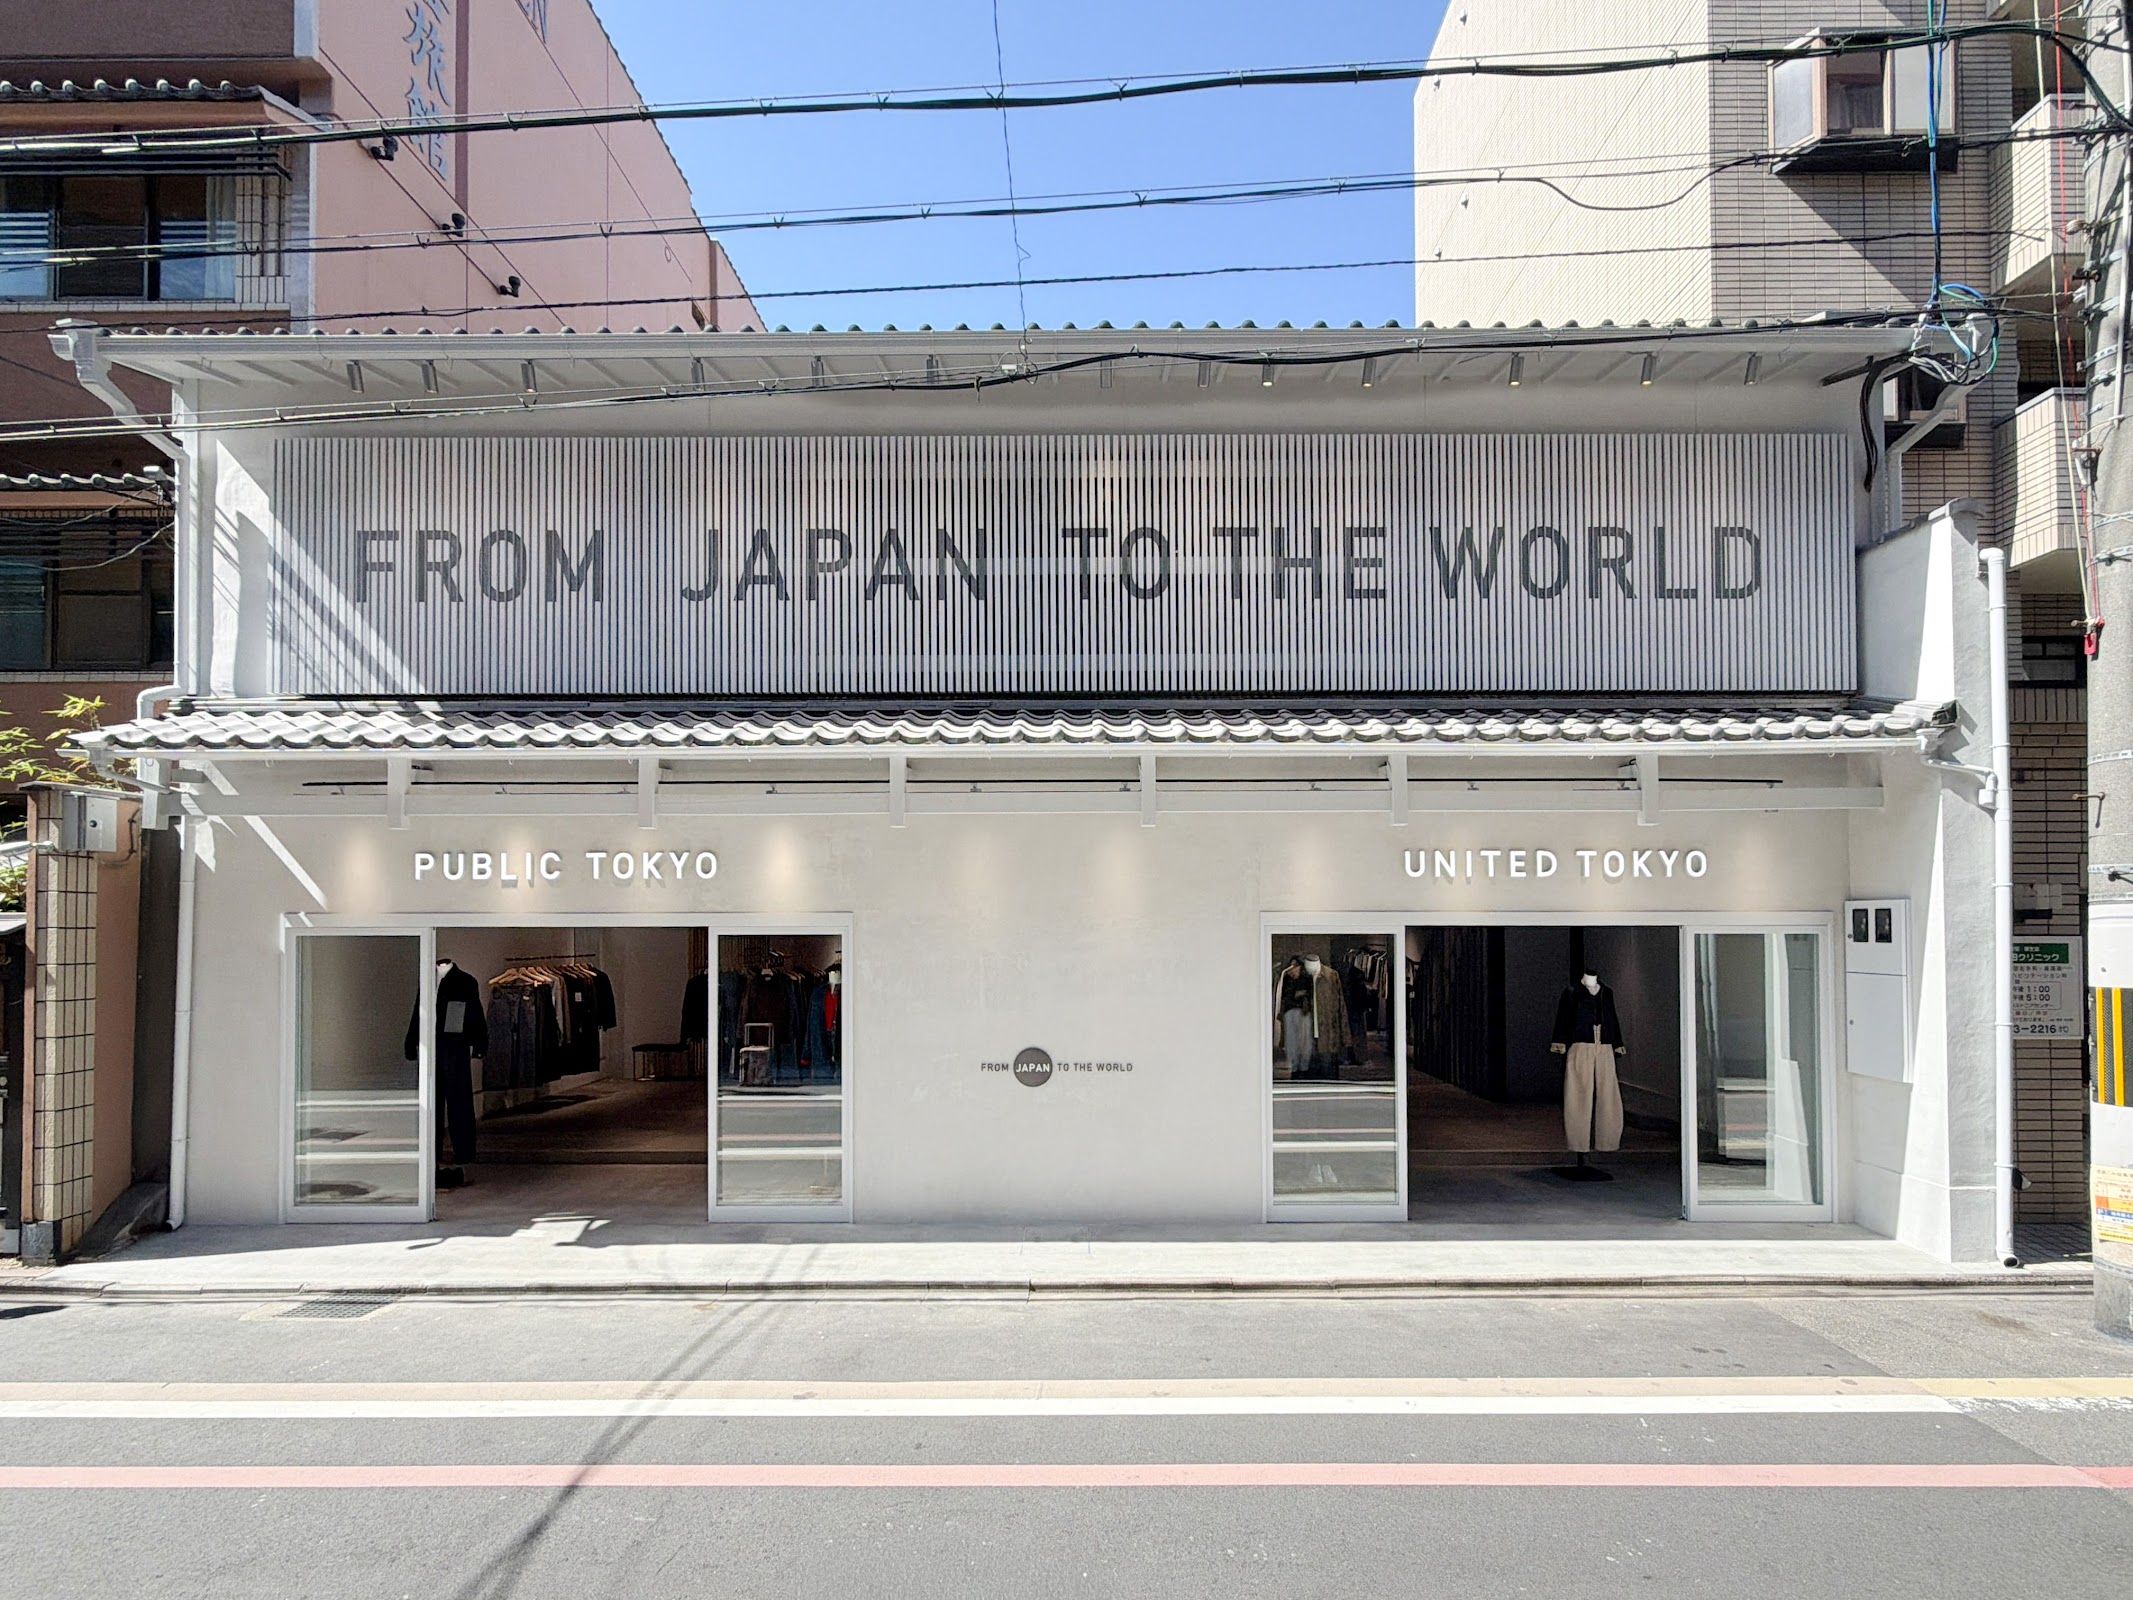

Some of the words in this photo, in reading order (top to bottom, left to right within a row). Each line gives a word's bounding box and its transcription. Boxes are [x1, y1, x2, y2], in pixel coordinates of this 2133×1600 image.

[356, 529, 605, 603] FROM
[681, 529, 985, 601] JAPAN
[1062, 527, 1169, 599] TO
[1211, 528, 1386, 598] THE
[1430, 527, 1761, 598] WORLD
[414, 852, 561, 880] PUBLIC
[586, 852, 718, 880] TOKYO
[1404, 850, 1559, 878] UNITED
[1576, 850, 1709, 878] TOKYO
[981, 1063, 1009, 1072] FROM
[1016, 1063, 1051, 1073] JAPAN
[1057, 1063, 1069, 1072] TO
[1073, 1063, 1092, 1072] THE
[1096, 1063, 1133, 1072] WORLD
